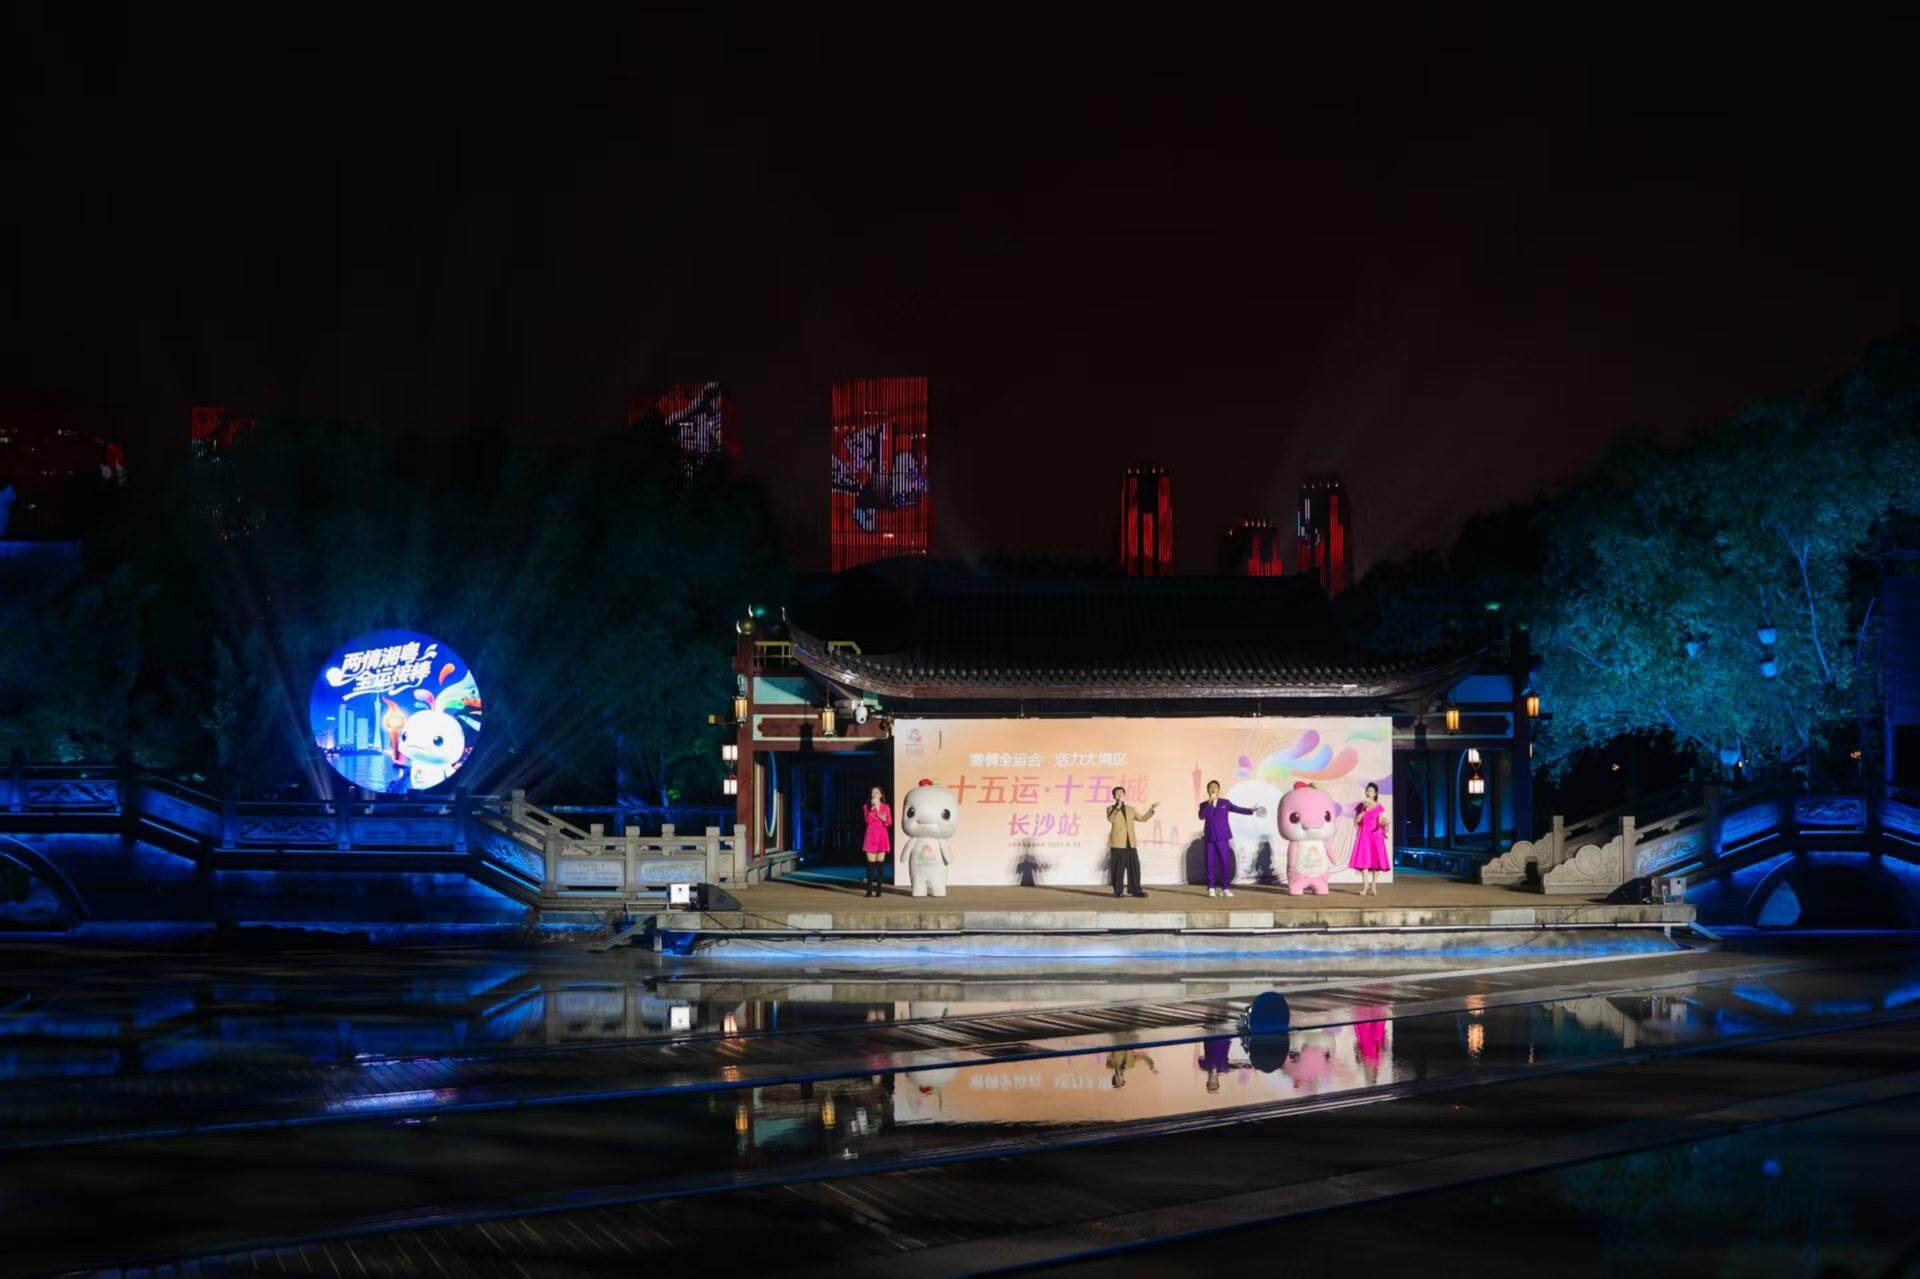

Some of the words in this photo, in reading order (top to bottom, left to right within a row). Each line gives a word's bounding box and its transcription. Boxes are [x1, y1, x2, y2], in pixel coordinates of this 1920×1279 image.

[970, 752, 1042, 767] 激情全运会
[1056, 752, 1127, 767] 活力大湾区
[1008, 814, 1080, 838] 长沙站
